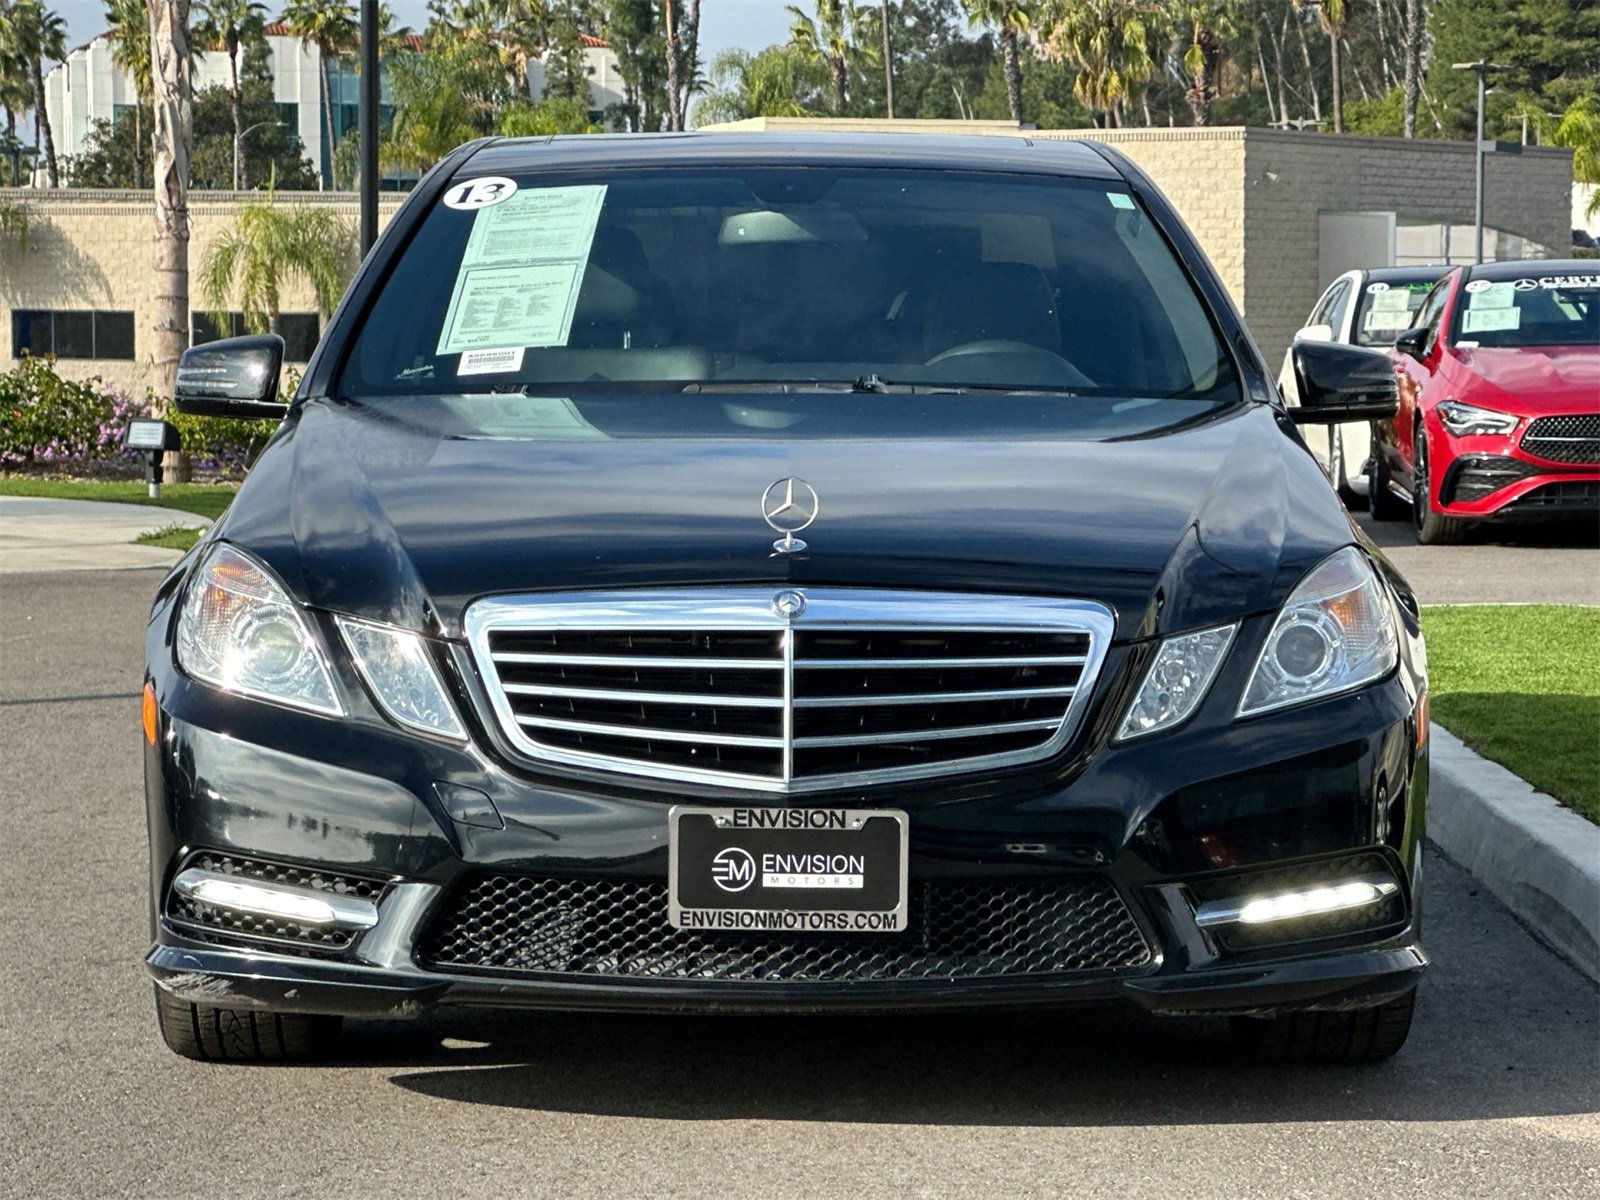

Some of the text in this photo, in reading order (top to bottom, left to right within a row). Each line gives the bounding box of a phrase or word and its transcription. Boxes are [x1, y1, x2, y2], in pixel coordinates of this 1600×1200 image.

[454, 183, 506, 204] 13
[733, 809, 846, 828] ENVISION
[762, 854, 864, 874] ENVISION
[770, 876, 855, 886] MOTORS
[679, 911, 898, 930] ENVISIONMOTORS.COM
